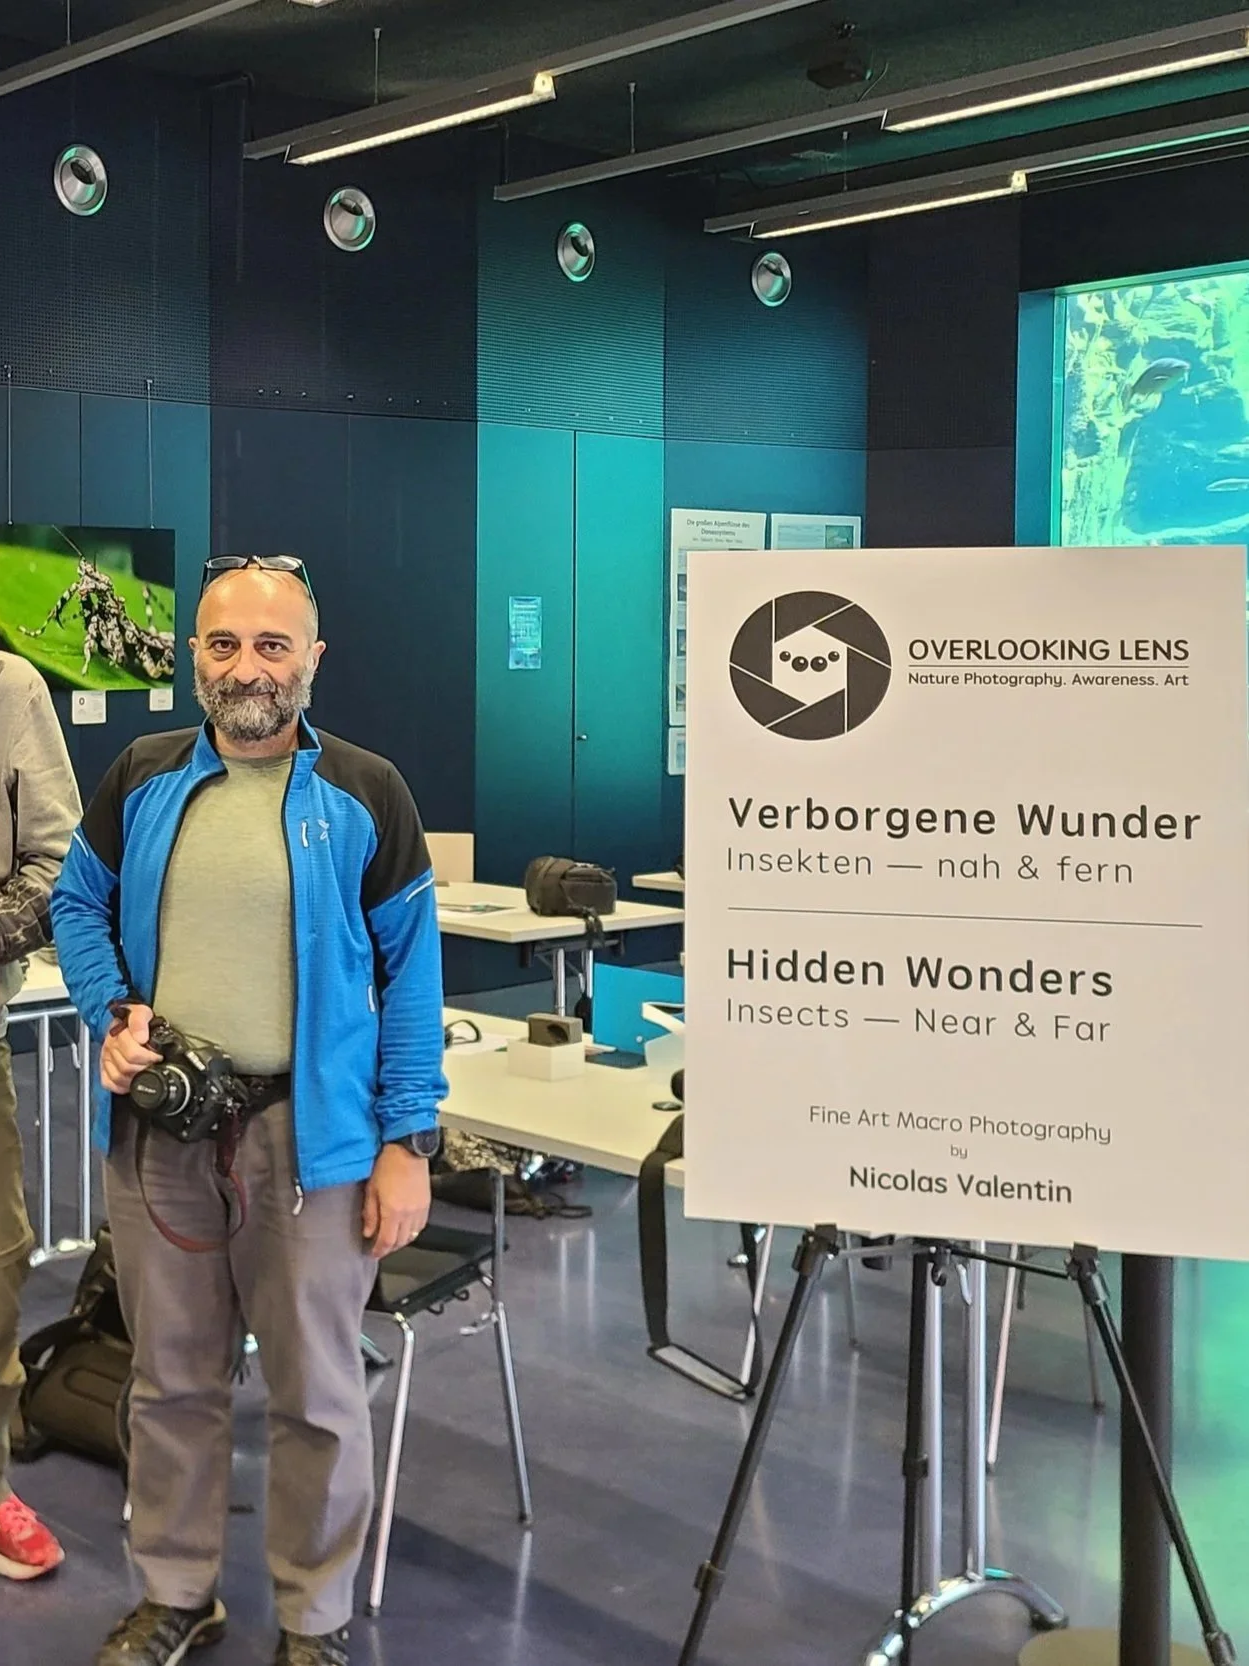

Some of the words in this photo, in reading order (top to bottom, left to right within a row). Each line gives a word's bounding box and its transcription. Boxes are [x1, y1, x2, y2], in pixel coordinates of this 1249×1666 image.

[908, 639, 1110, 661] OVERLOOKING
[1120, 639, 1190, 661] LENS
[908, 672, 960, 686] Nature
[964, 671, 1067, 689] Photography.
[1071, 673, 1159, 687] Awareness.
[1163, 673, 1189, 687] Art
[728, 797, 996, 840] Verborgene
[1017, 803, 1202, 840] Wunder
[727, 847, 872, 875] Insekten
[938, 853, 1000, 880] nah
[1017, 854, 1039, 881] &
[1056, 855, 1132, 884] fern
[728, 948, 884, 987] Hidden
[906, 955, 1113, 997] Wonders
[727, 998, 849, 1028] Insects
[915, 1007, 997, 1036] Near
[1014, 1012, 1037, 1038] &
[1054, 1015, 1111, 1042] Far
[809, 1105, 851, 1125] Fine
[857, 1109, 890, 1128] Art
[896, 1111, 963, 1133] Macro
[969, 1115, 1111, 1146] Photography
[950, 1143, 968, 1160] by
[850, 1165, 948, 1194] Nicolas
[957, 1173, 1072, 1204] Valentin
